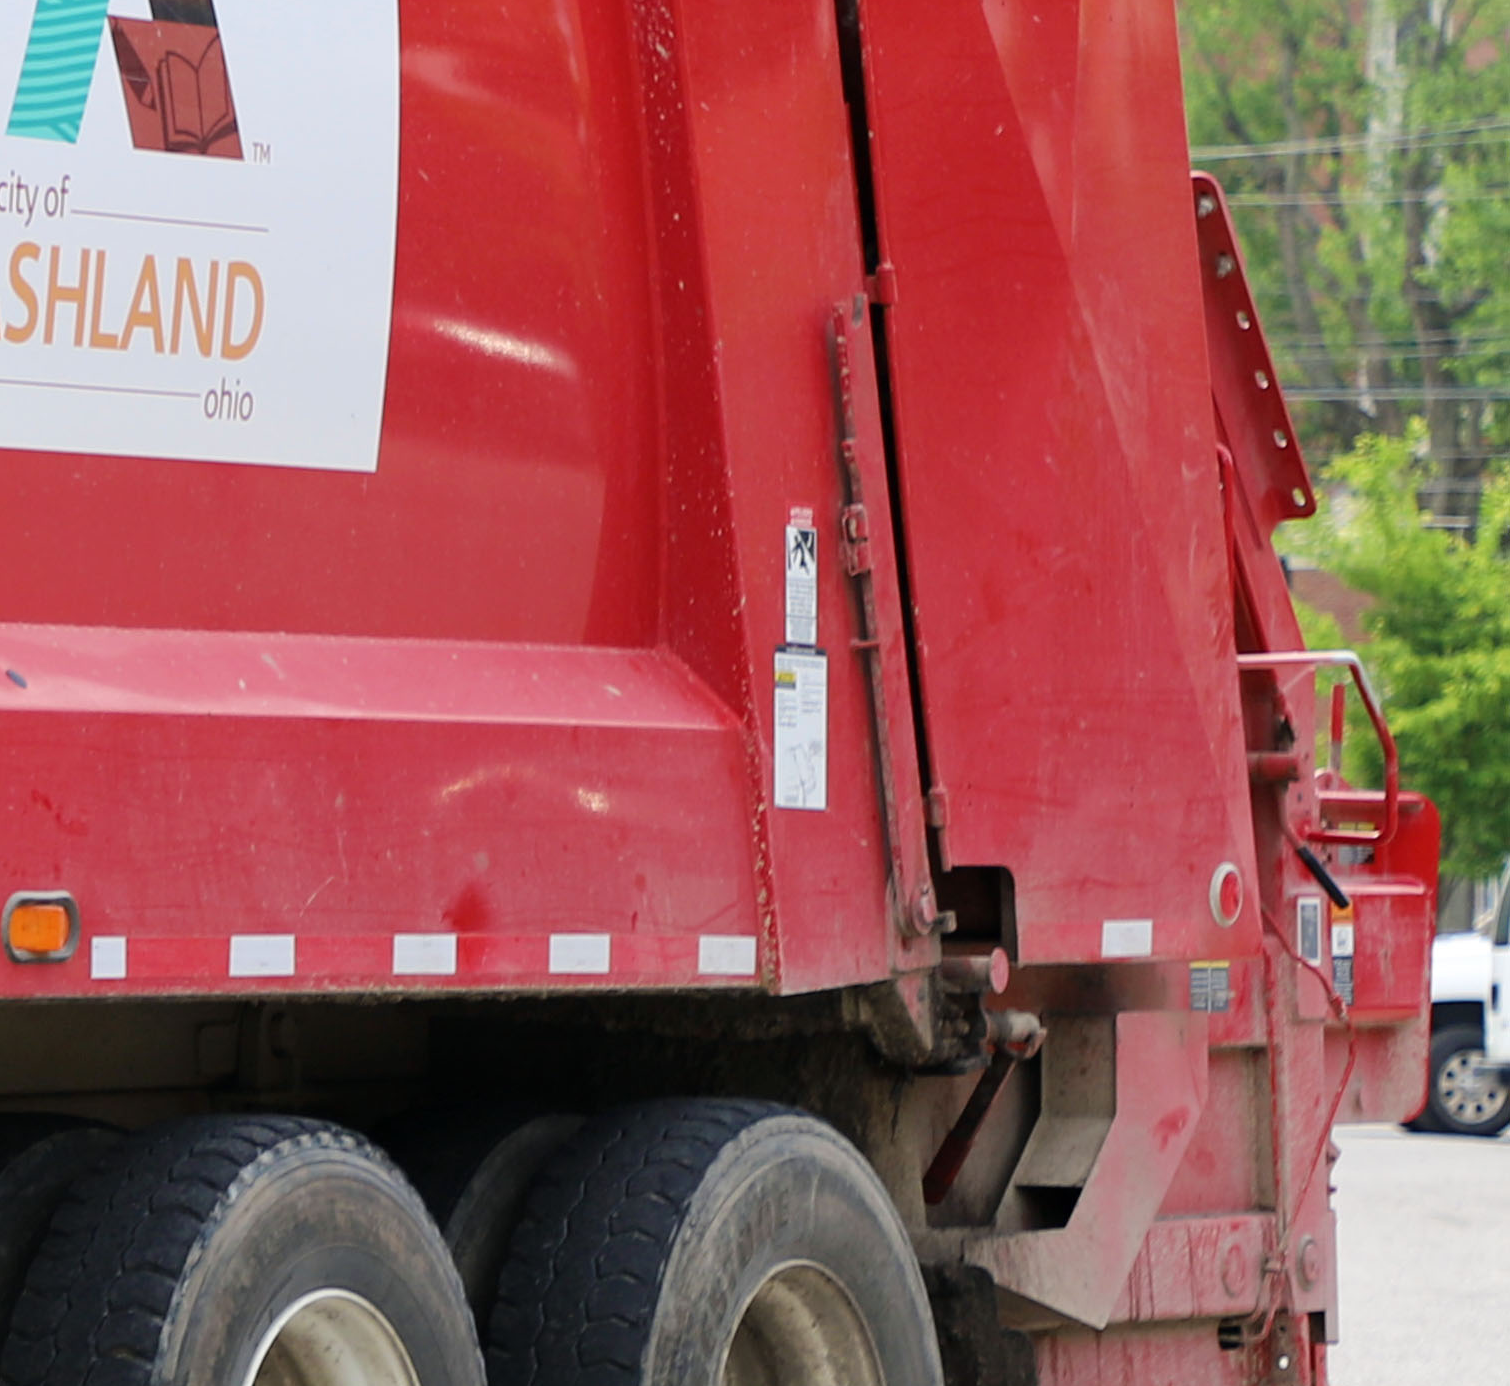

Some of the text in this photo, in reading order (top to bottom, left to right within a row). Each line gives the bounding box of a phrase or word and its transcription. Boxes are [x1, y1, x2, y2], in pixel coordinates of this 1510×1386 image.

[251, 142, 271, 164] TM
[43, 174, 71, 218] of
[203, 376, 254, 421] ohio
